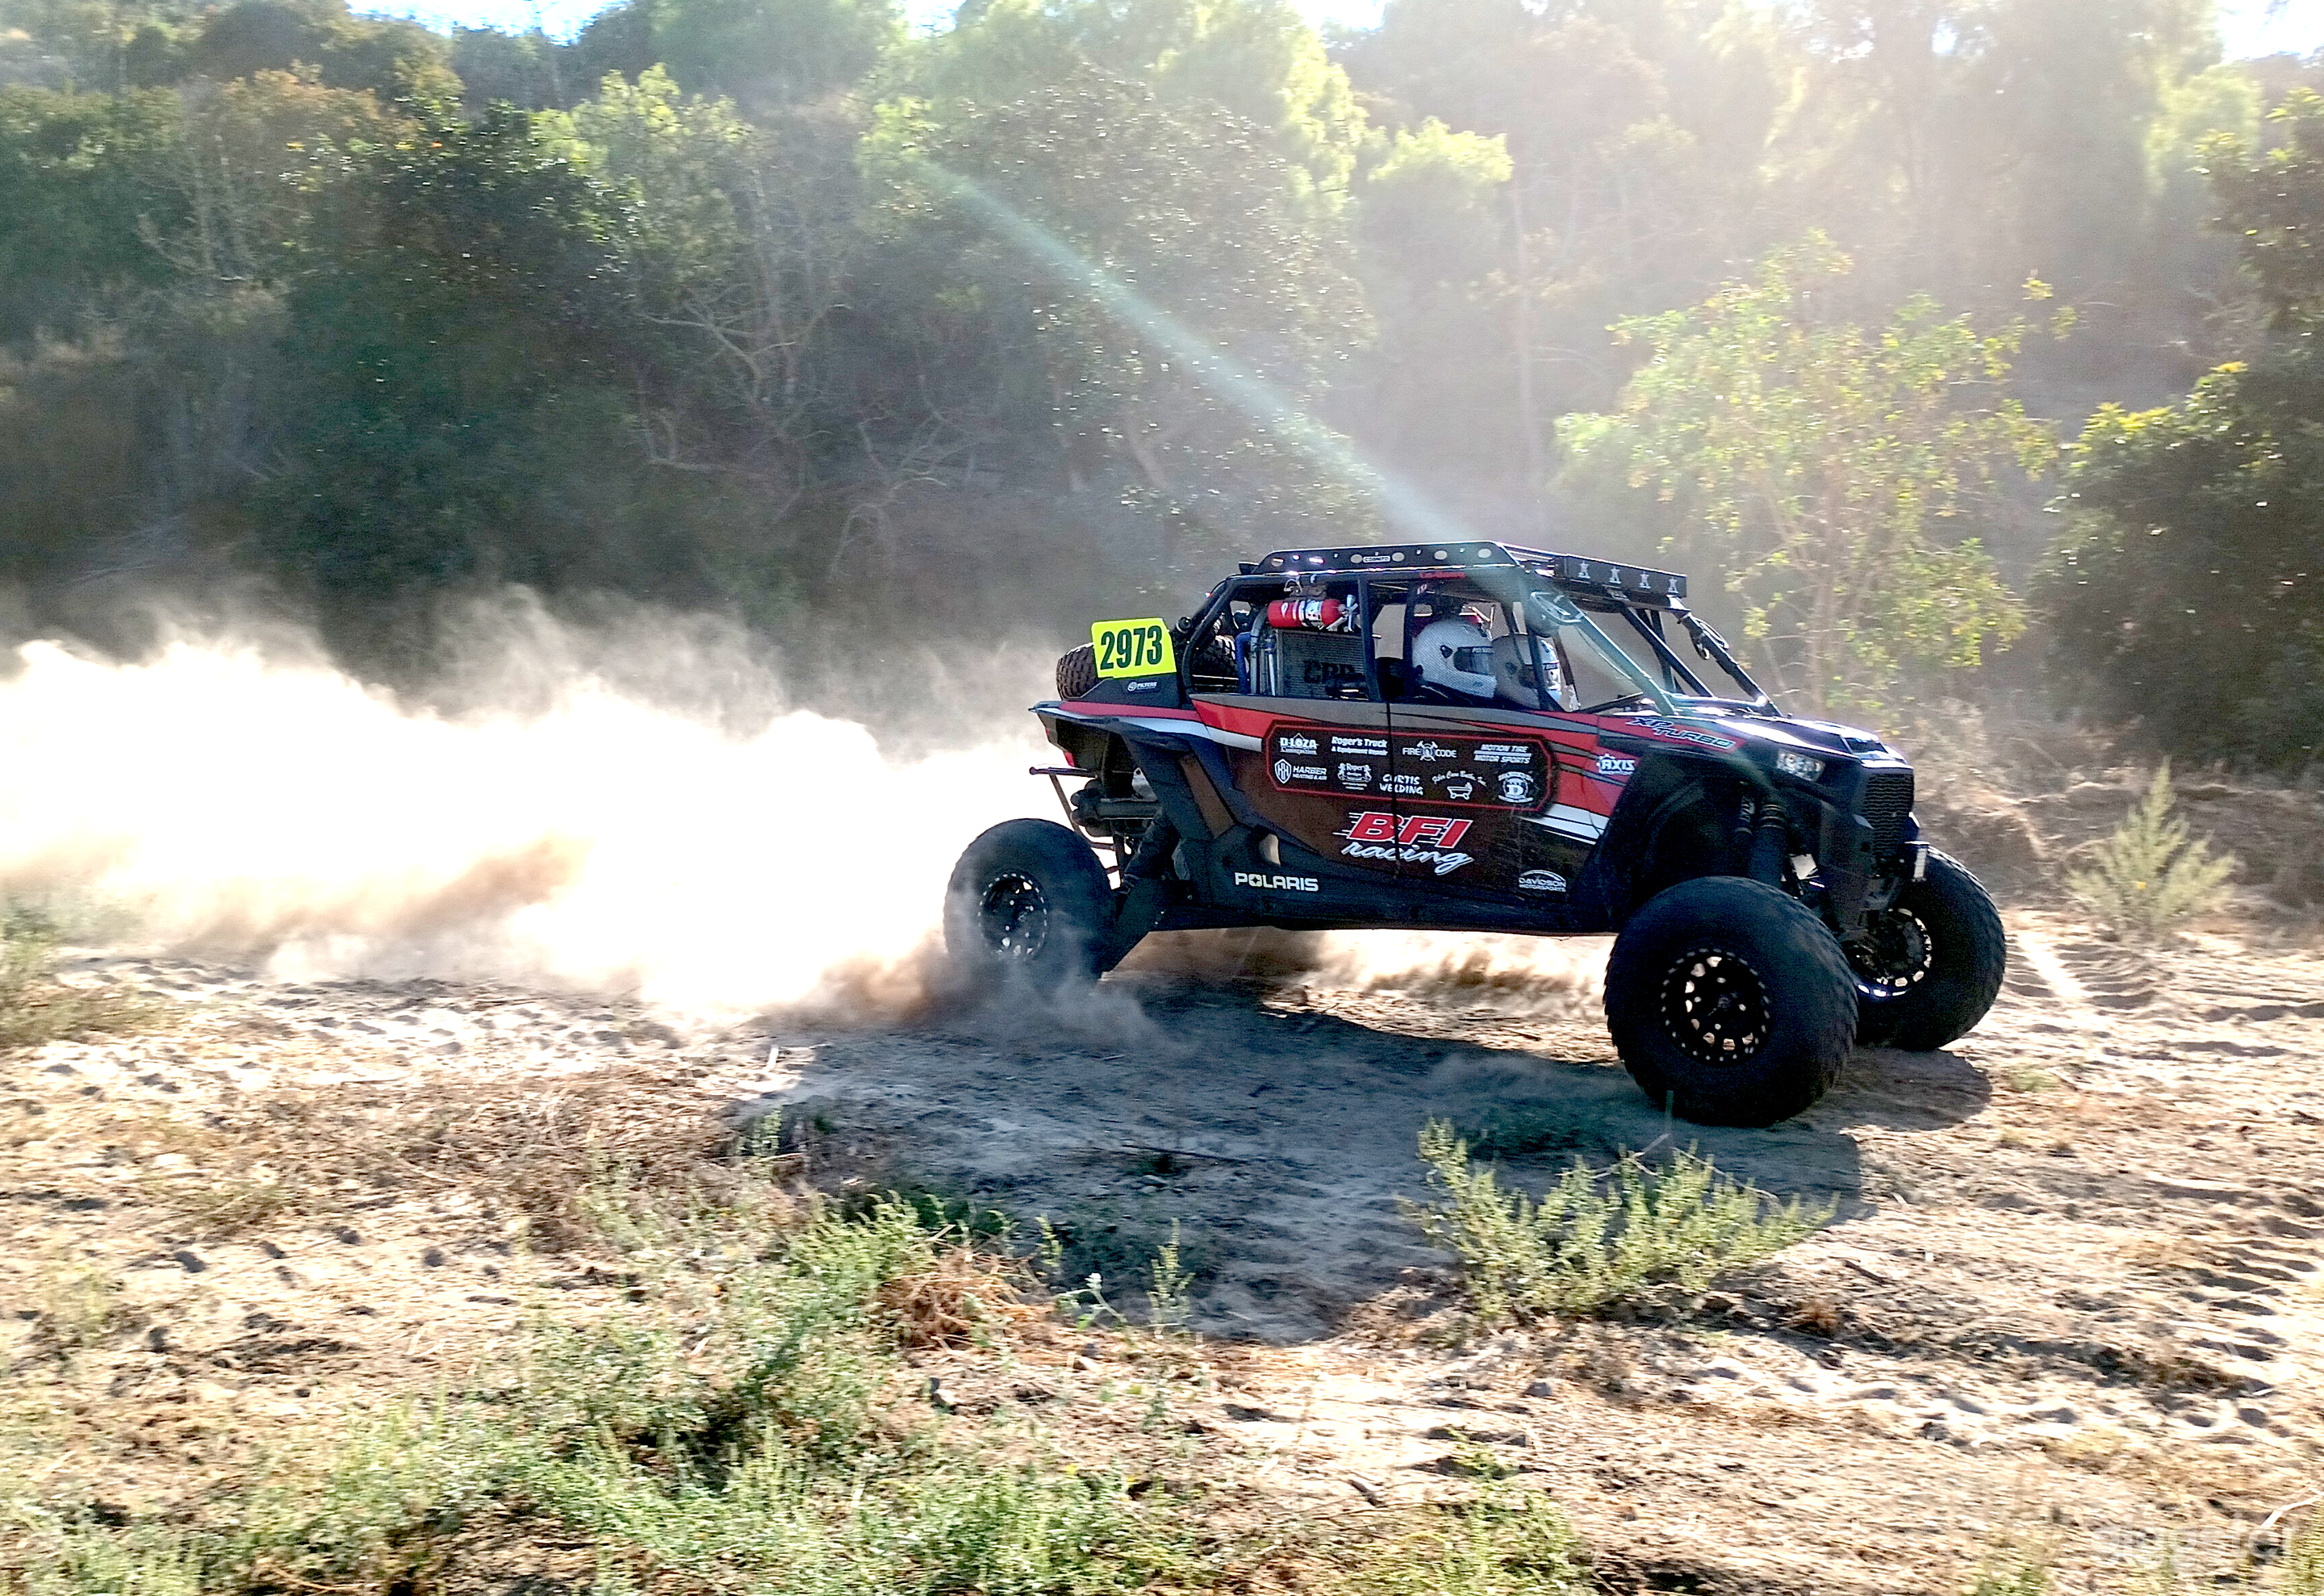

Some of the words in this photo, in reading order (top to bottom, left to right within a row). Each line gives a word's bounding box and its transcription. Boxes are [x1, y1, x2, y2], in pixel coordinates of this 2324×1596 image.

[1100, 625, 1162, 670] 2973
[1625, 717, 1674, 728] XP
[1331, 736, 1363, 746] Roger's
[1364, 739, 1388, 747] Truck
[1653, 727, 1736, 750] TURBO
[1402, 747, 1420, 755] FIRE
[1436, 749, 1457, 758] CODE
[1293, 766, 1327, 775] HARBER
[1602, 759, 1635, 771] AXIS
[1382, 774, 1419, 785] CURTIS
[1379, 783, 1423, 796] WELDING
[1346, 812, 1473, 848] BFI
[1341, 842, 1474, 875] racing
[1235, 872, 1319, 892] POLARIS
[1519, 877, 1565, 888] DAVIDSON
